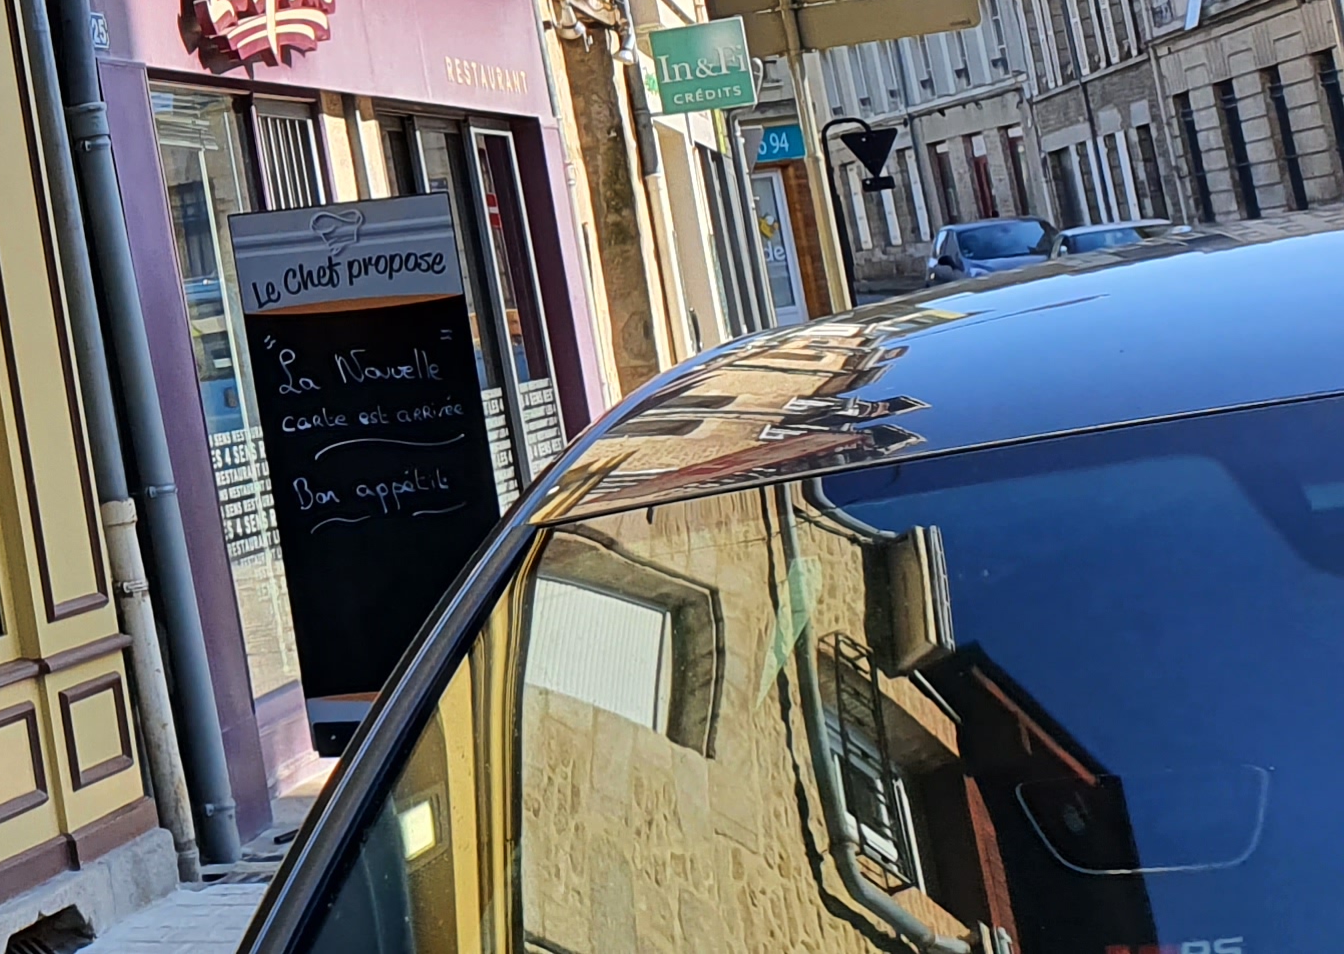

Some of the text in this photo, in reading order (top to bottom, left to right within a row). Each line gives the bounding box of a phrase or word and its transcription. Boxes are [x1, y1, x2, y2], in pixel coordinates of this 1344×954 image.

[445, 56, 528, 95] RESTAURANT
[673, 85, 742, 104] CRÉDITS
[769, 131, 790, 154] 94
[252, 252, 446, 309] Le Chef propose
[358, 405, 390, 425] est
[293, 477, 340, 510] Bon
